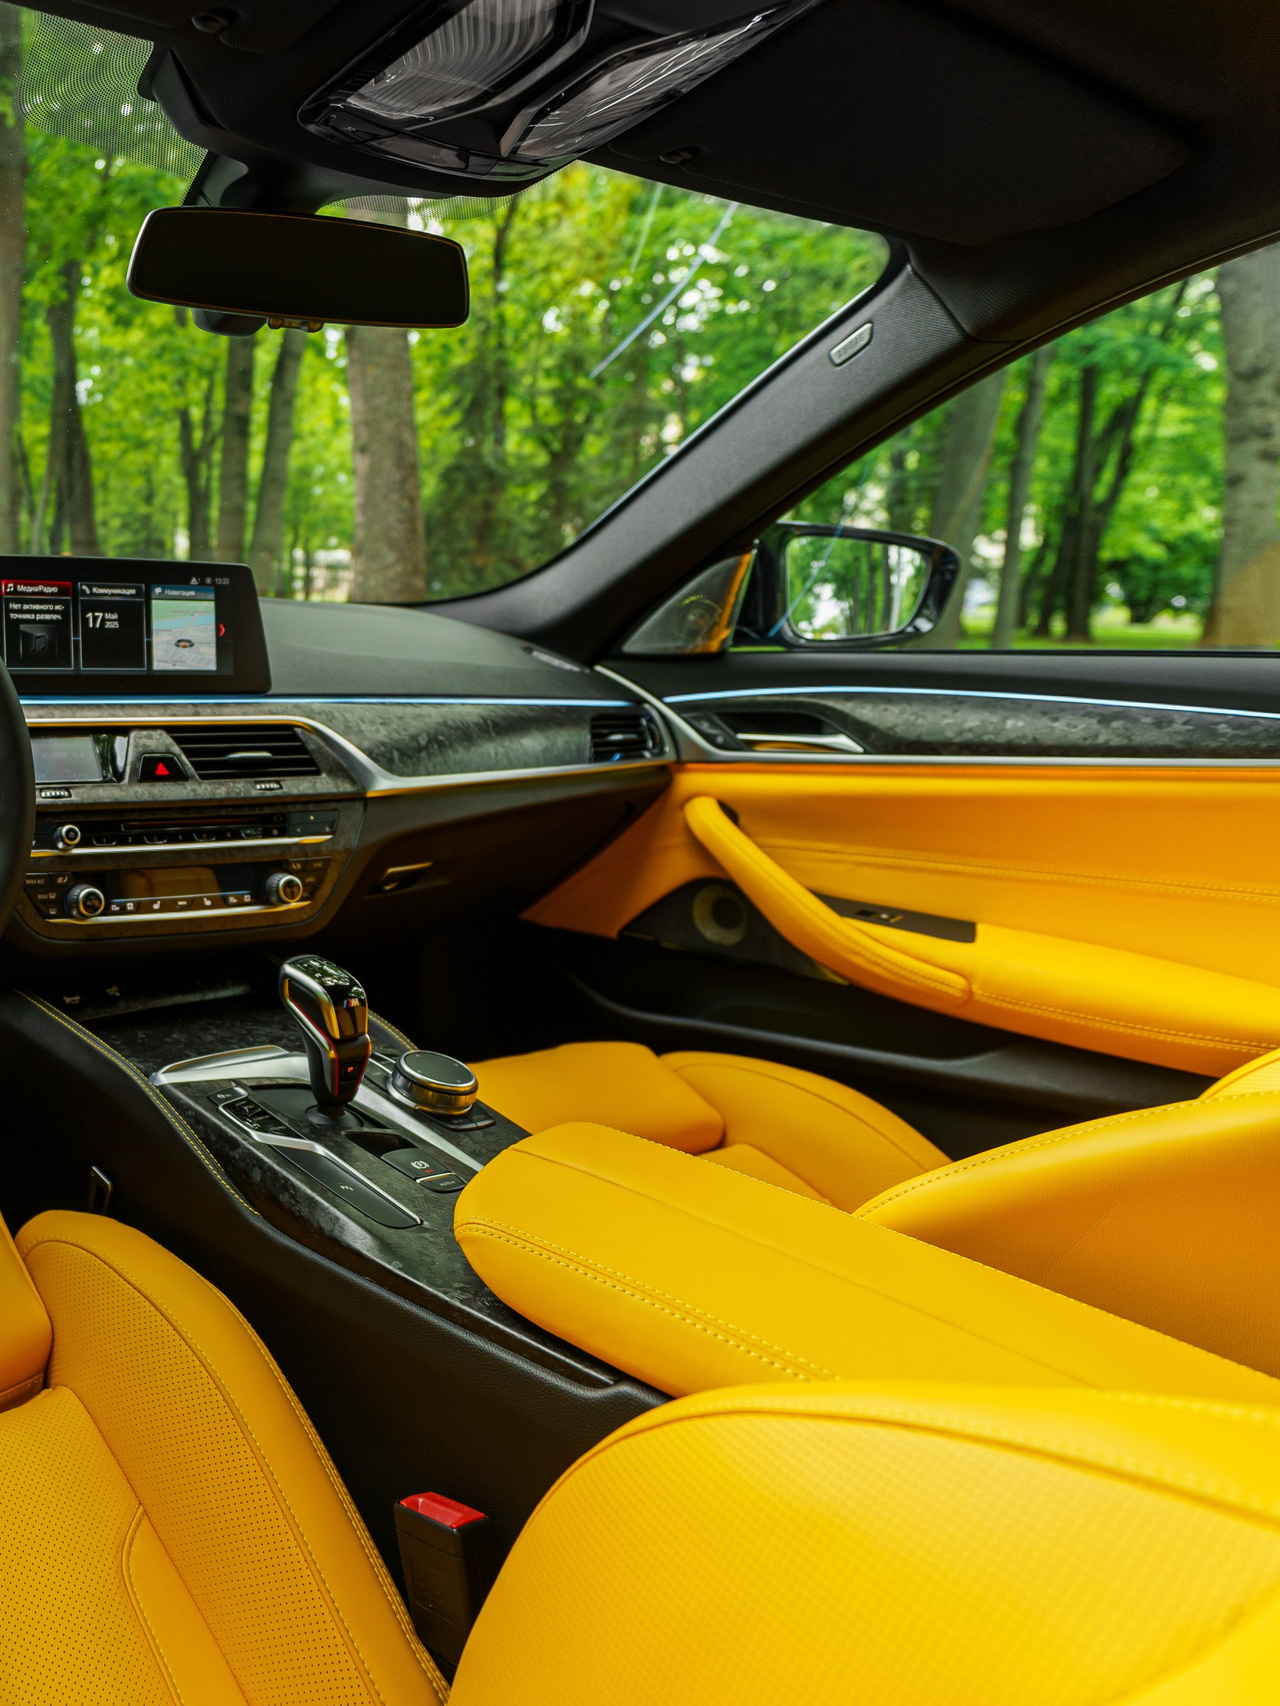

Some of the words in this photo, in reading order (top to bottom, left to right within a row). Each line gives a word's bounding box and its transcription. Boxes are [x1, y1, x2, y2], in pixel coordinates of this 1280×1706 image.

[17, 584, 59, 594] Медиа/Радио
[92, 587, 137, 596] Коммуникация
[165, 589, 196, 597] Навигация
[85, 612, 103, 628] 17
[105, 612, 118, 620] Май
